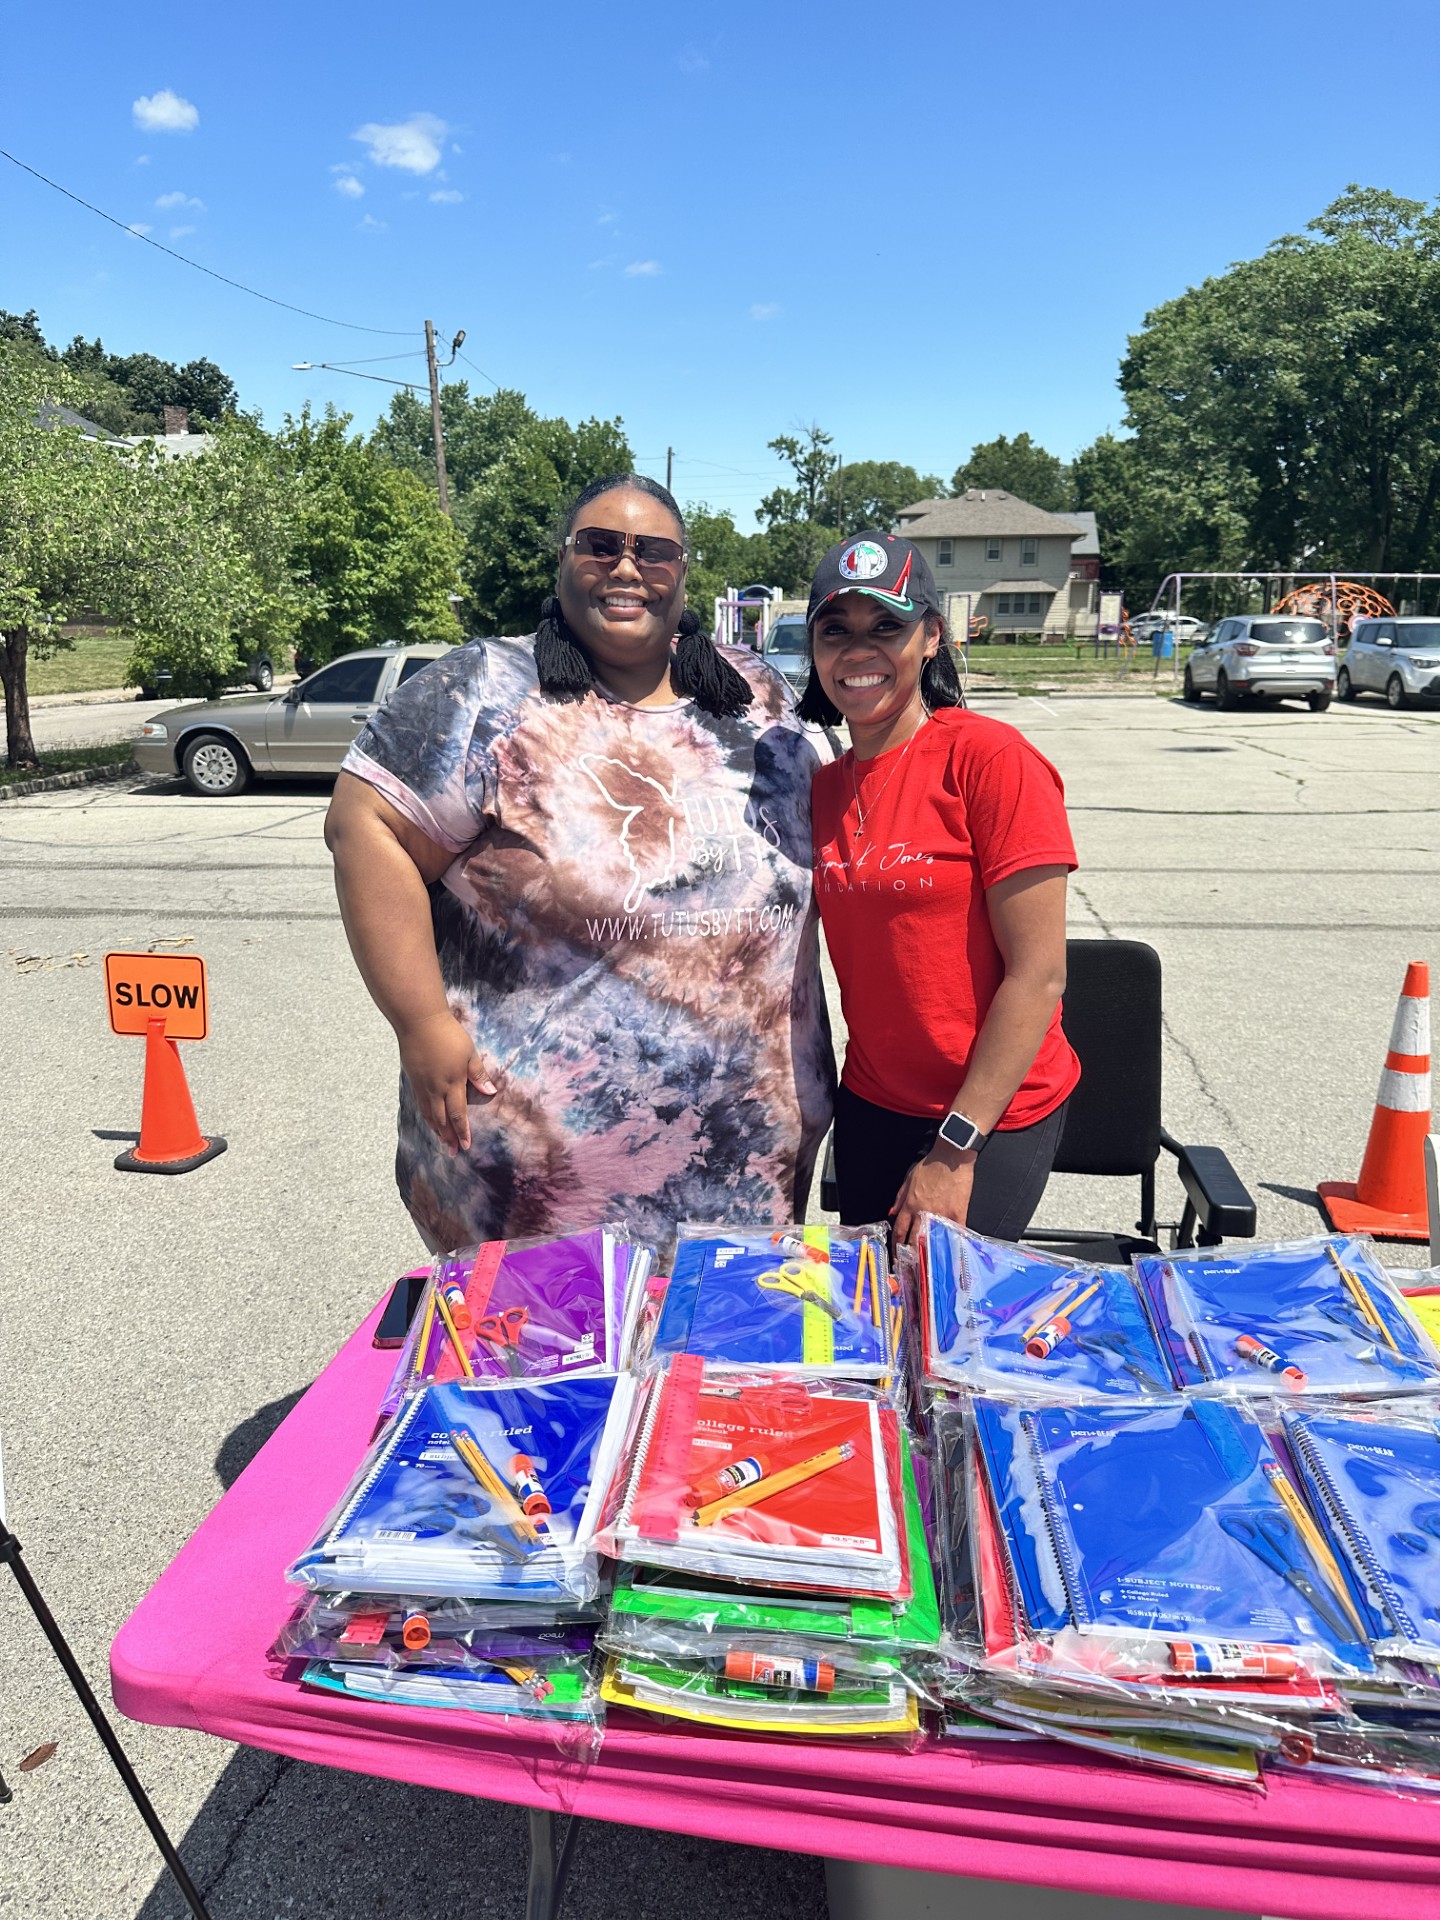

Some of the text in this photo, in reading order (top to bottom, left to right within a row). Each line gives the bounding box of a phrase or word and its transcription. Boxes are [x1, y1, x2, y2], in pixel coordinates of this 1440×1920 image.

[680, 795, 781, 848] TUTUS
[880, 841, 935, 871] Jones
[585, 904, 794, 941] WWW.TUTUSBYTT.COM
[115, 982, 199, 1009] SLOW
[696, 1419, 746, 1433] ollege
[1116, 1577, 1168, 1587] 1-SUBJECT
[1168, 1581, 1223, 1592] NOTEBOOK
